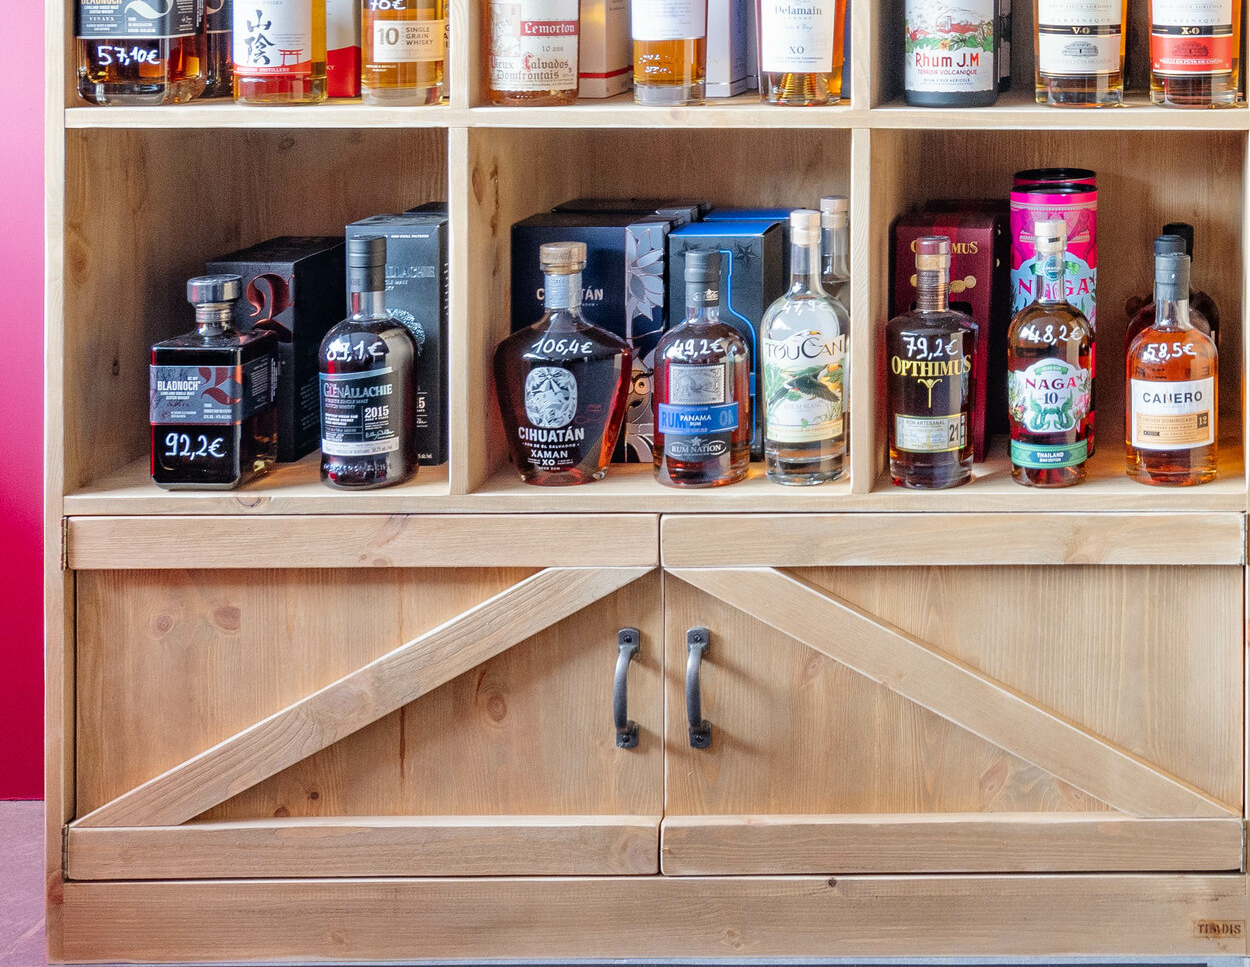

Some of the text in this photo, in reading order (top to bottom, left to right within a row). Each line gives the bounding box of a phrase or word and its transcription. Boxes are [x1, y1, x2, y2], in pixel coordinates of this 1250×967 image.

[524, 22, 575, 34] Lemorton
[377, 27, 400, 45] 10
[96, 45, 162, 67] 57,10€
[790, 45, 804, 55] XO
[916, 52, 980, 67] Rhum J.M
[530, 338, 593, 355] 106,4€
[902, 337, 959, 361] 79,2€
[891, 355, 972, 377] OPTHIMUS
[157, 381, 199, 391] BLADNOCH
[1024, 377, 1077, 390] NAGA
[1042, 392, 1058, 405] 10
[364, 405, 390, 419] 2015
[518, 426, 584, 443] CIHUATÁN
[949, 423, 959, 441] 21
[164, 433, 226, 461] 92,2€
[530, 449, 568, 459] XAMAN
[690, 444, 722, 453] NATION
